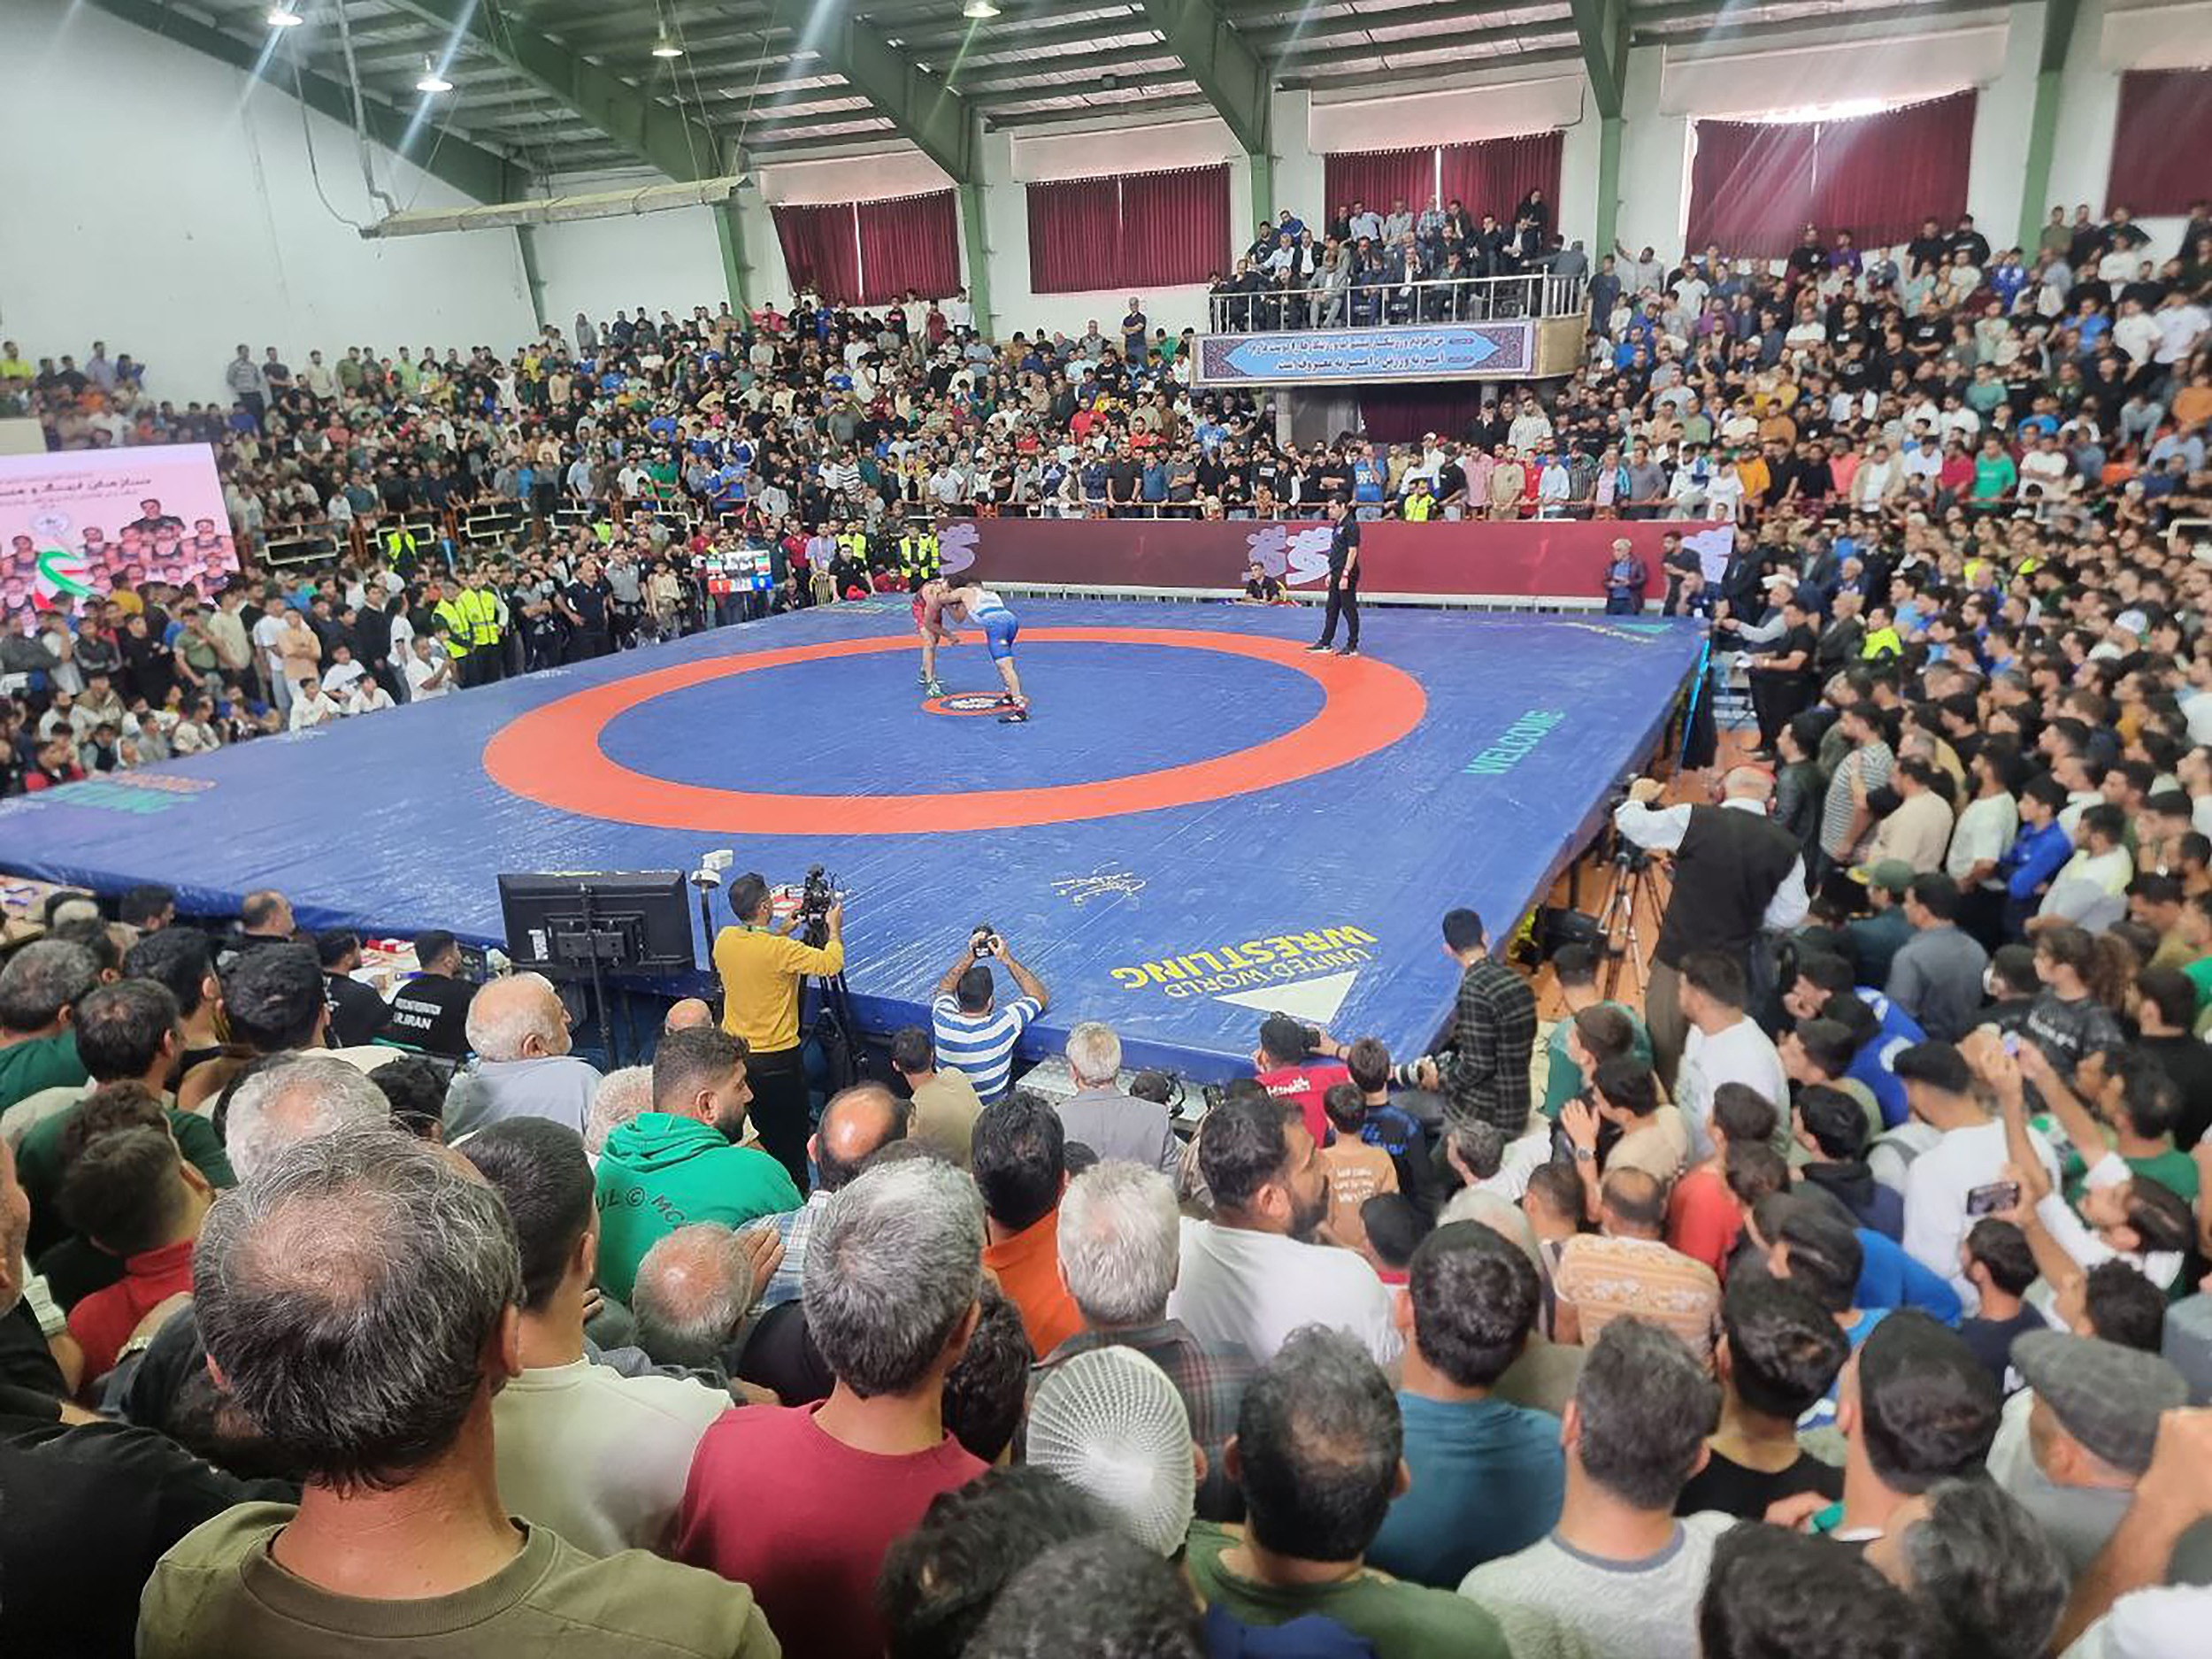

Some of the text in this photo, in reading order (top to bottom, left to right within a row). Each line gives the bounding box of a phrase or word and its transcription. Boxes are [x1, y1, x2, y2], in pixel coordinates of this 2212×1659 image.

[1461, 709, 1566, 774] WELCOME
[1110, 925, 1378, 989] WRESTLING
[1164, 948, 1371, 998] UNITED WORLD
